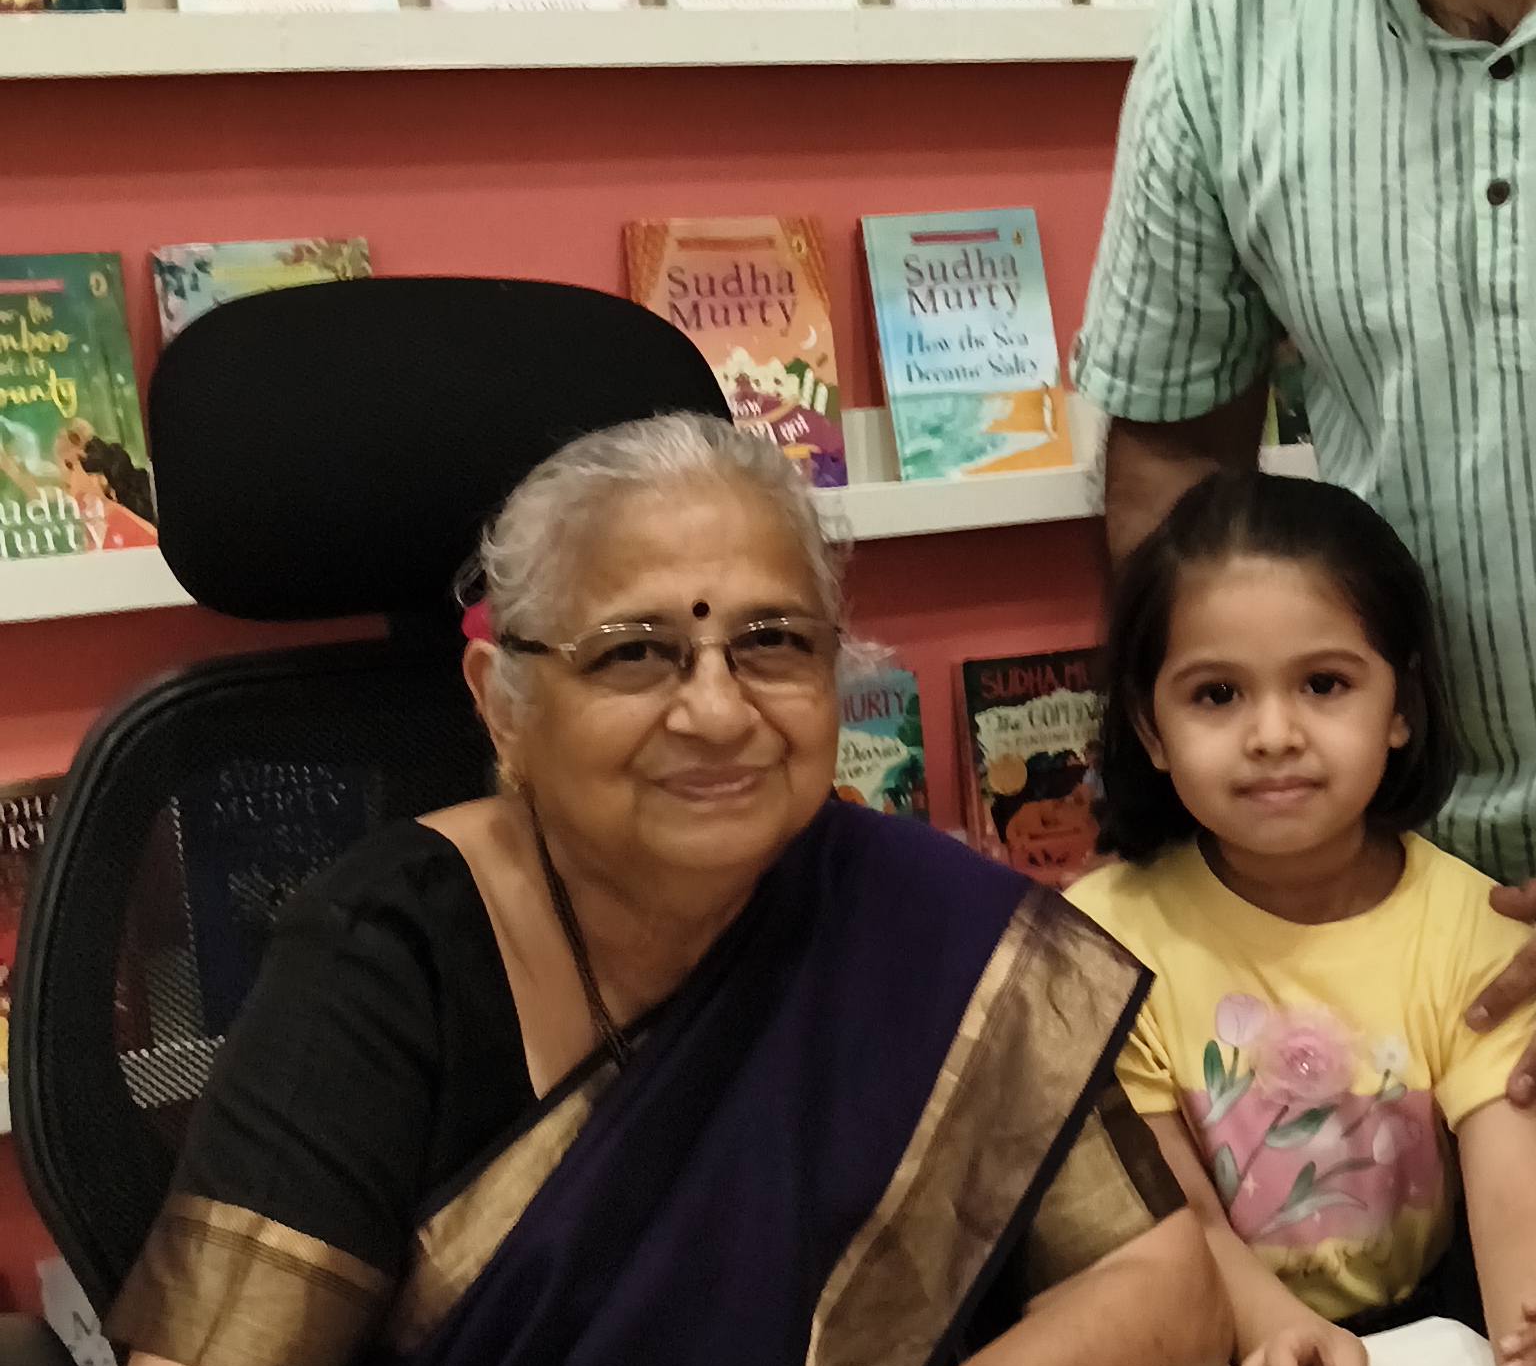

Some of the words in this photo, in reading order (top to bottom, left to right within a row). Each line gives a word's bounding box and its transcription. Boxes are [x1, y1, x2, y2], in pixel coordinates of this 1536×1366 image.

[667, 260, 796, 299] Sudha
[903, 248, 1019, 286] Sudha
[668, 298, 796, 337] Murty
[906, 283, 1021, 318] Murty
[0, 315, 69, 353] mboo
[906, 330, 951, 356] How
[959, 323, 985, 351] the
[0, 367, 78, 419] ounty
[0, 486, 105, 527] udha
[0, 515, 107, 558] urty
